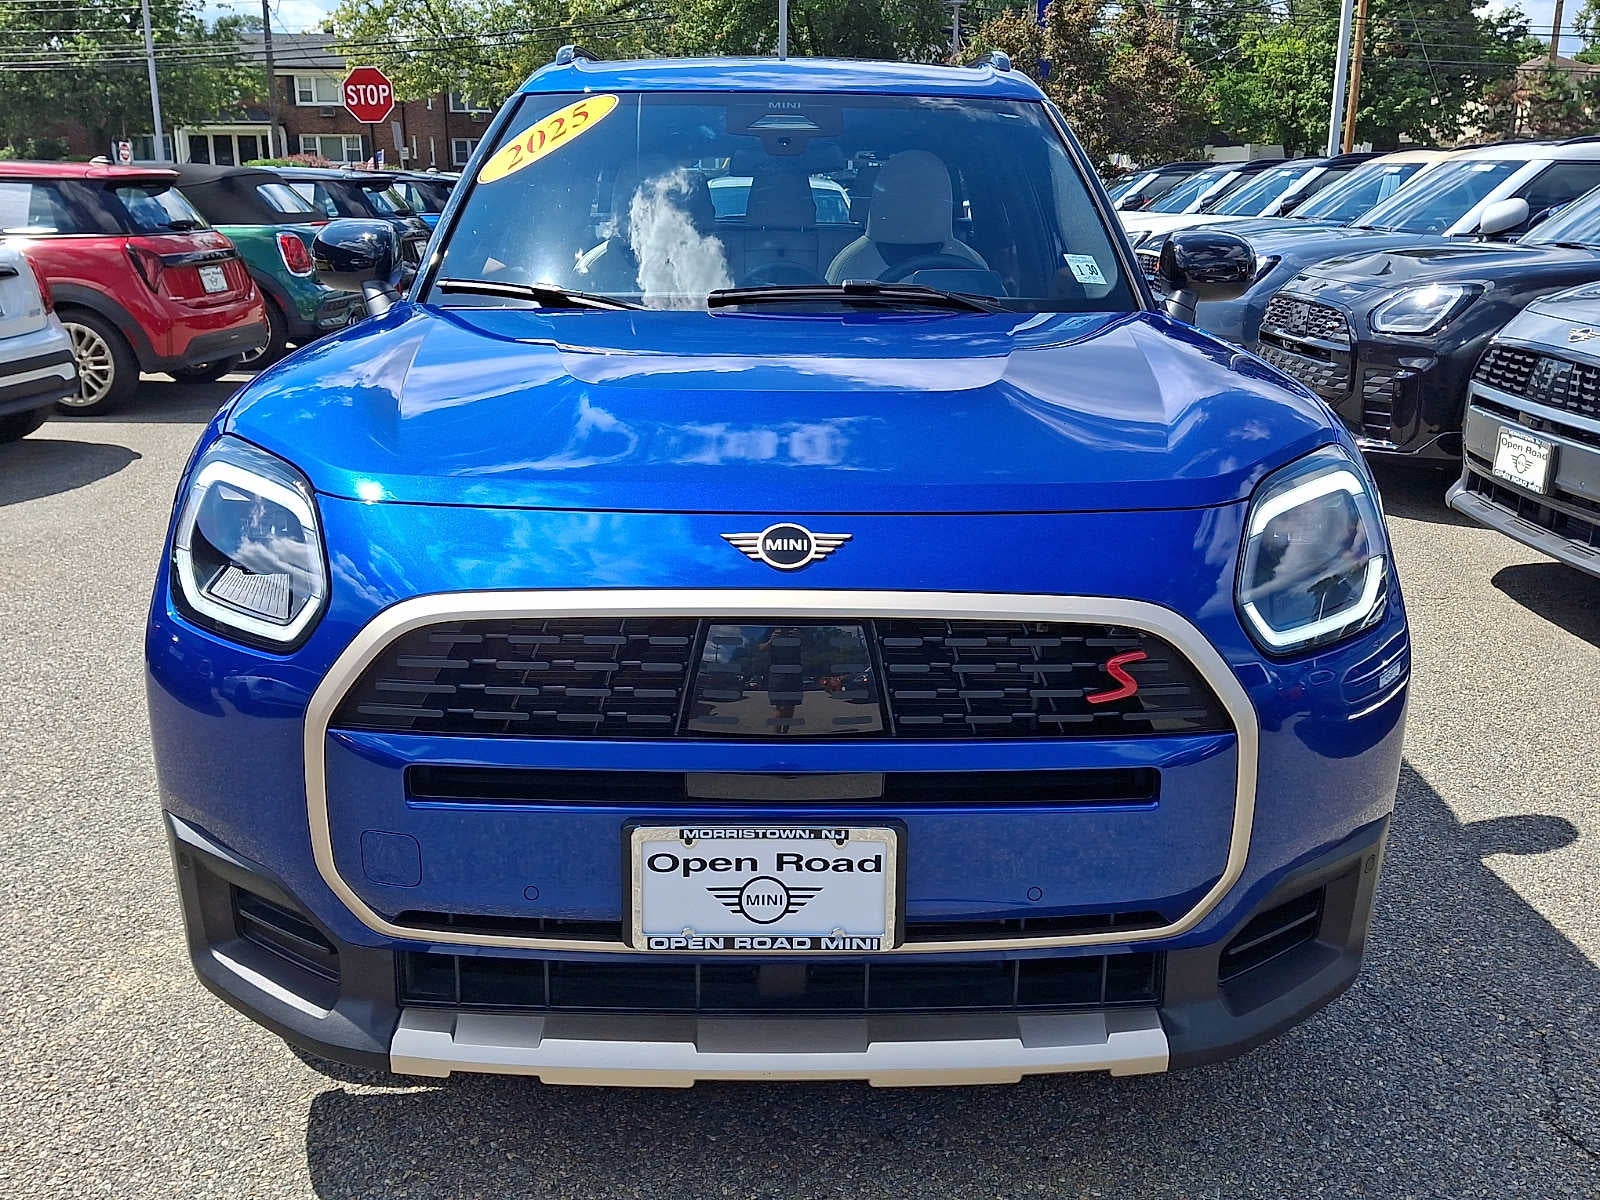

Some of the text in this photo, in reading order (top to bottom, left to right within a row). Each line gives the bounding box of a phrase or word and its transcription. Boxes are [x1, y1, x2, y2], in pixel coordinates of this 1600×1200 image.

[346, 84, 390, 106] STOP
[506, 102, 592, 170] 2025
[1501, 437, 1523, 452] Open
[1525, 445, 1548, 461] Road
[765, 539, 808, 551] MINI
[1085, 650, 1148, 704] S
[682, 829, 847, 840] MORRISTOWN, NJ
[647, 852, 882, 877] Open Road
[746, 894, 784, 906] MINI
[649, 937, 879, 950] OPEN ROAD MINI
